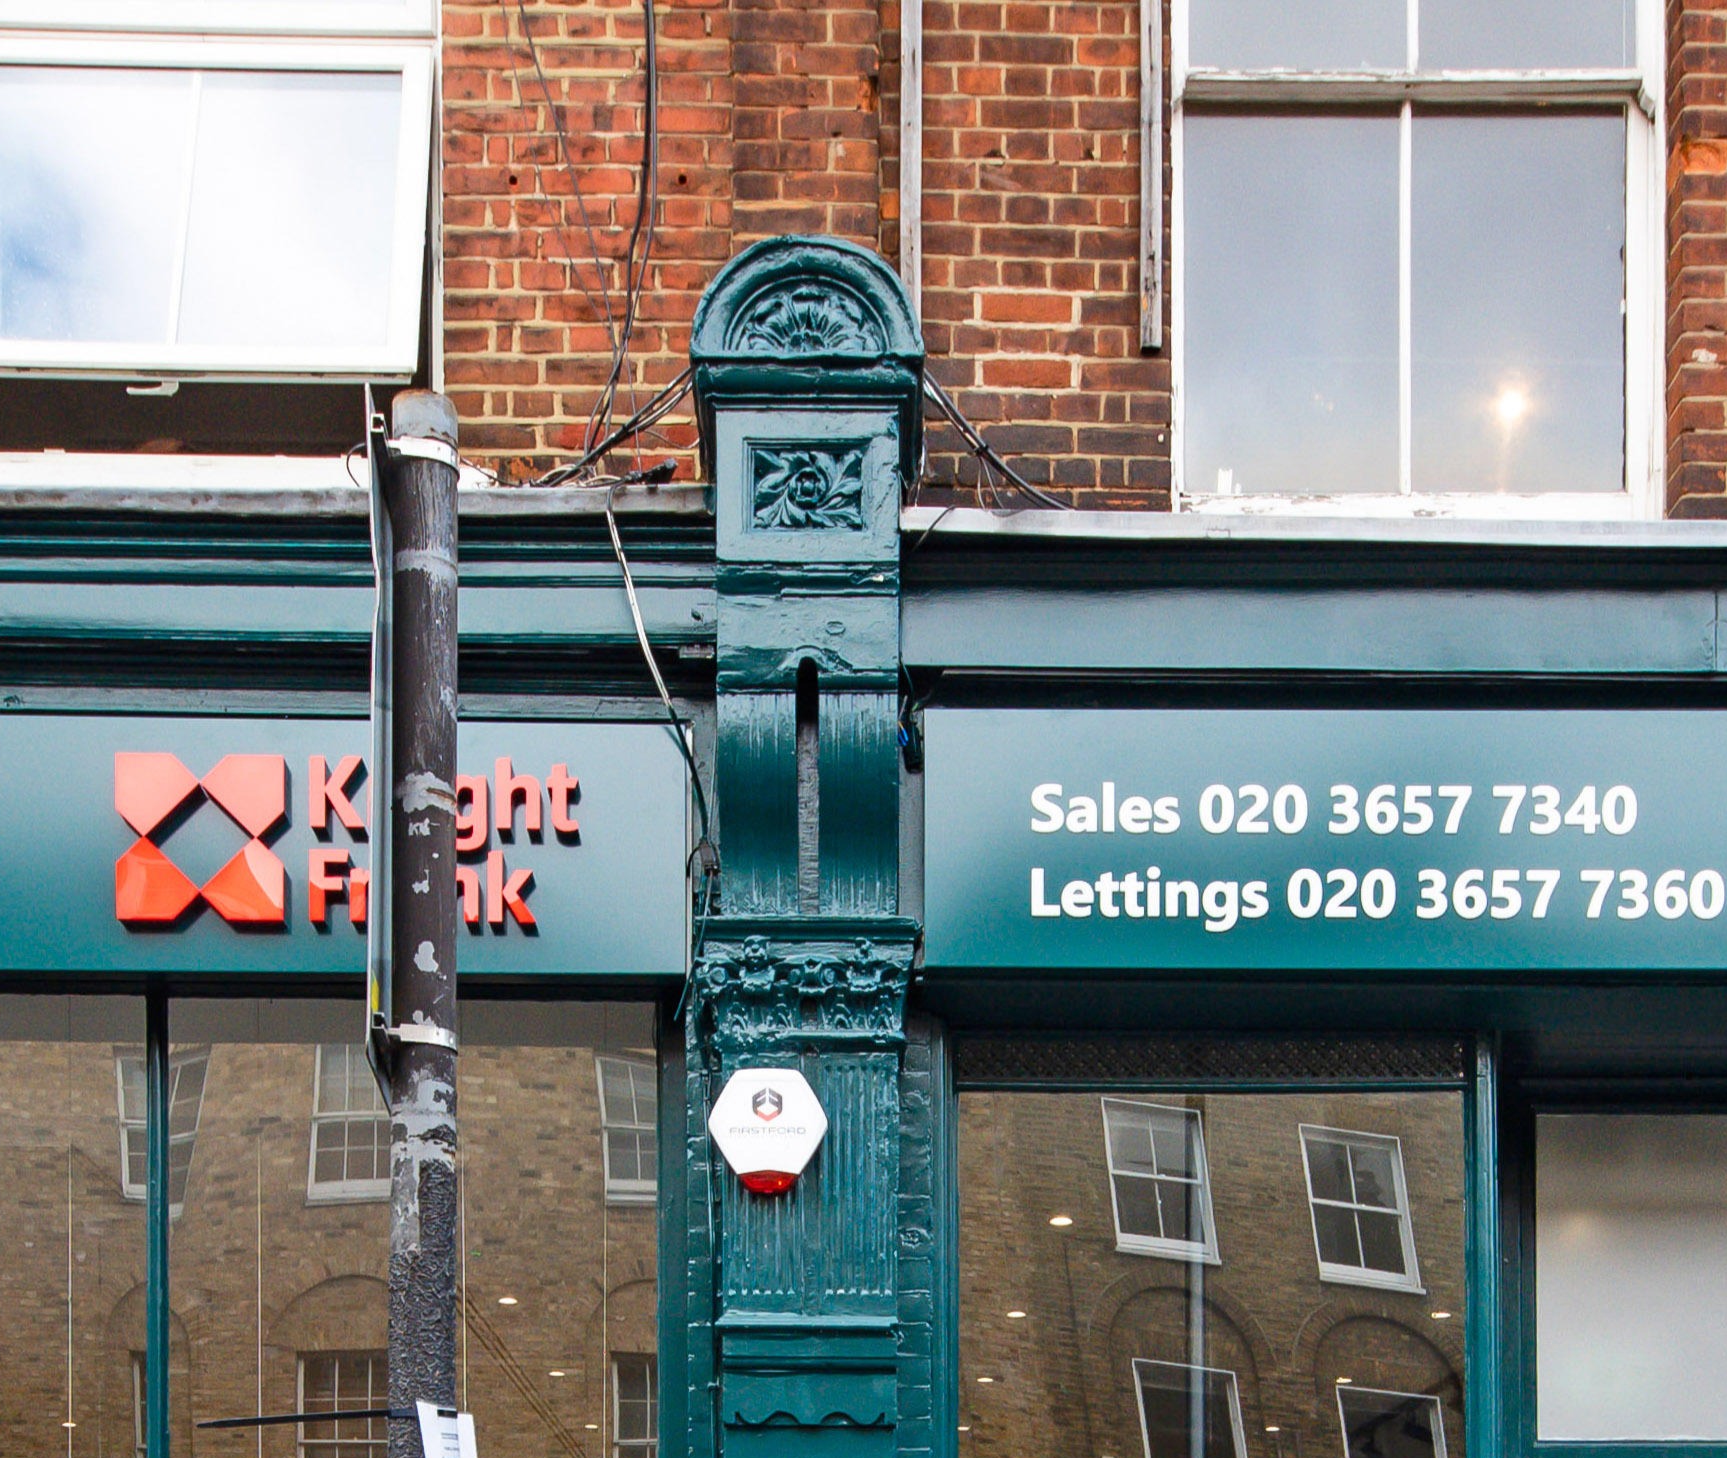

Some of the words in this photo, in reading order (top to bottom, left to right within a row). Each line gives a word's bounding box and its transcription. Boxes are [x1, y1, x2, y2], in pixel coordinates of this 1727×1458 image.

[309, 755, 579, 850] Kght
[1030, 781, 1181, 834] Sales
[1198, 783, 1308, 835] 020
[1328, 784, 1473, 835] 3657
[1492, 784, 1638, 835] 7340
[309, 849, 536, 924] Frk
[1030, 866, 1269, 932] Lettings
[1287, 868, 1396, 919] 020
[1416, 868, 1561, 920] 3657
[1580, 868, 1725, 920] 7360
